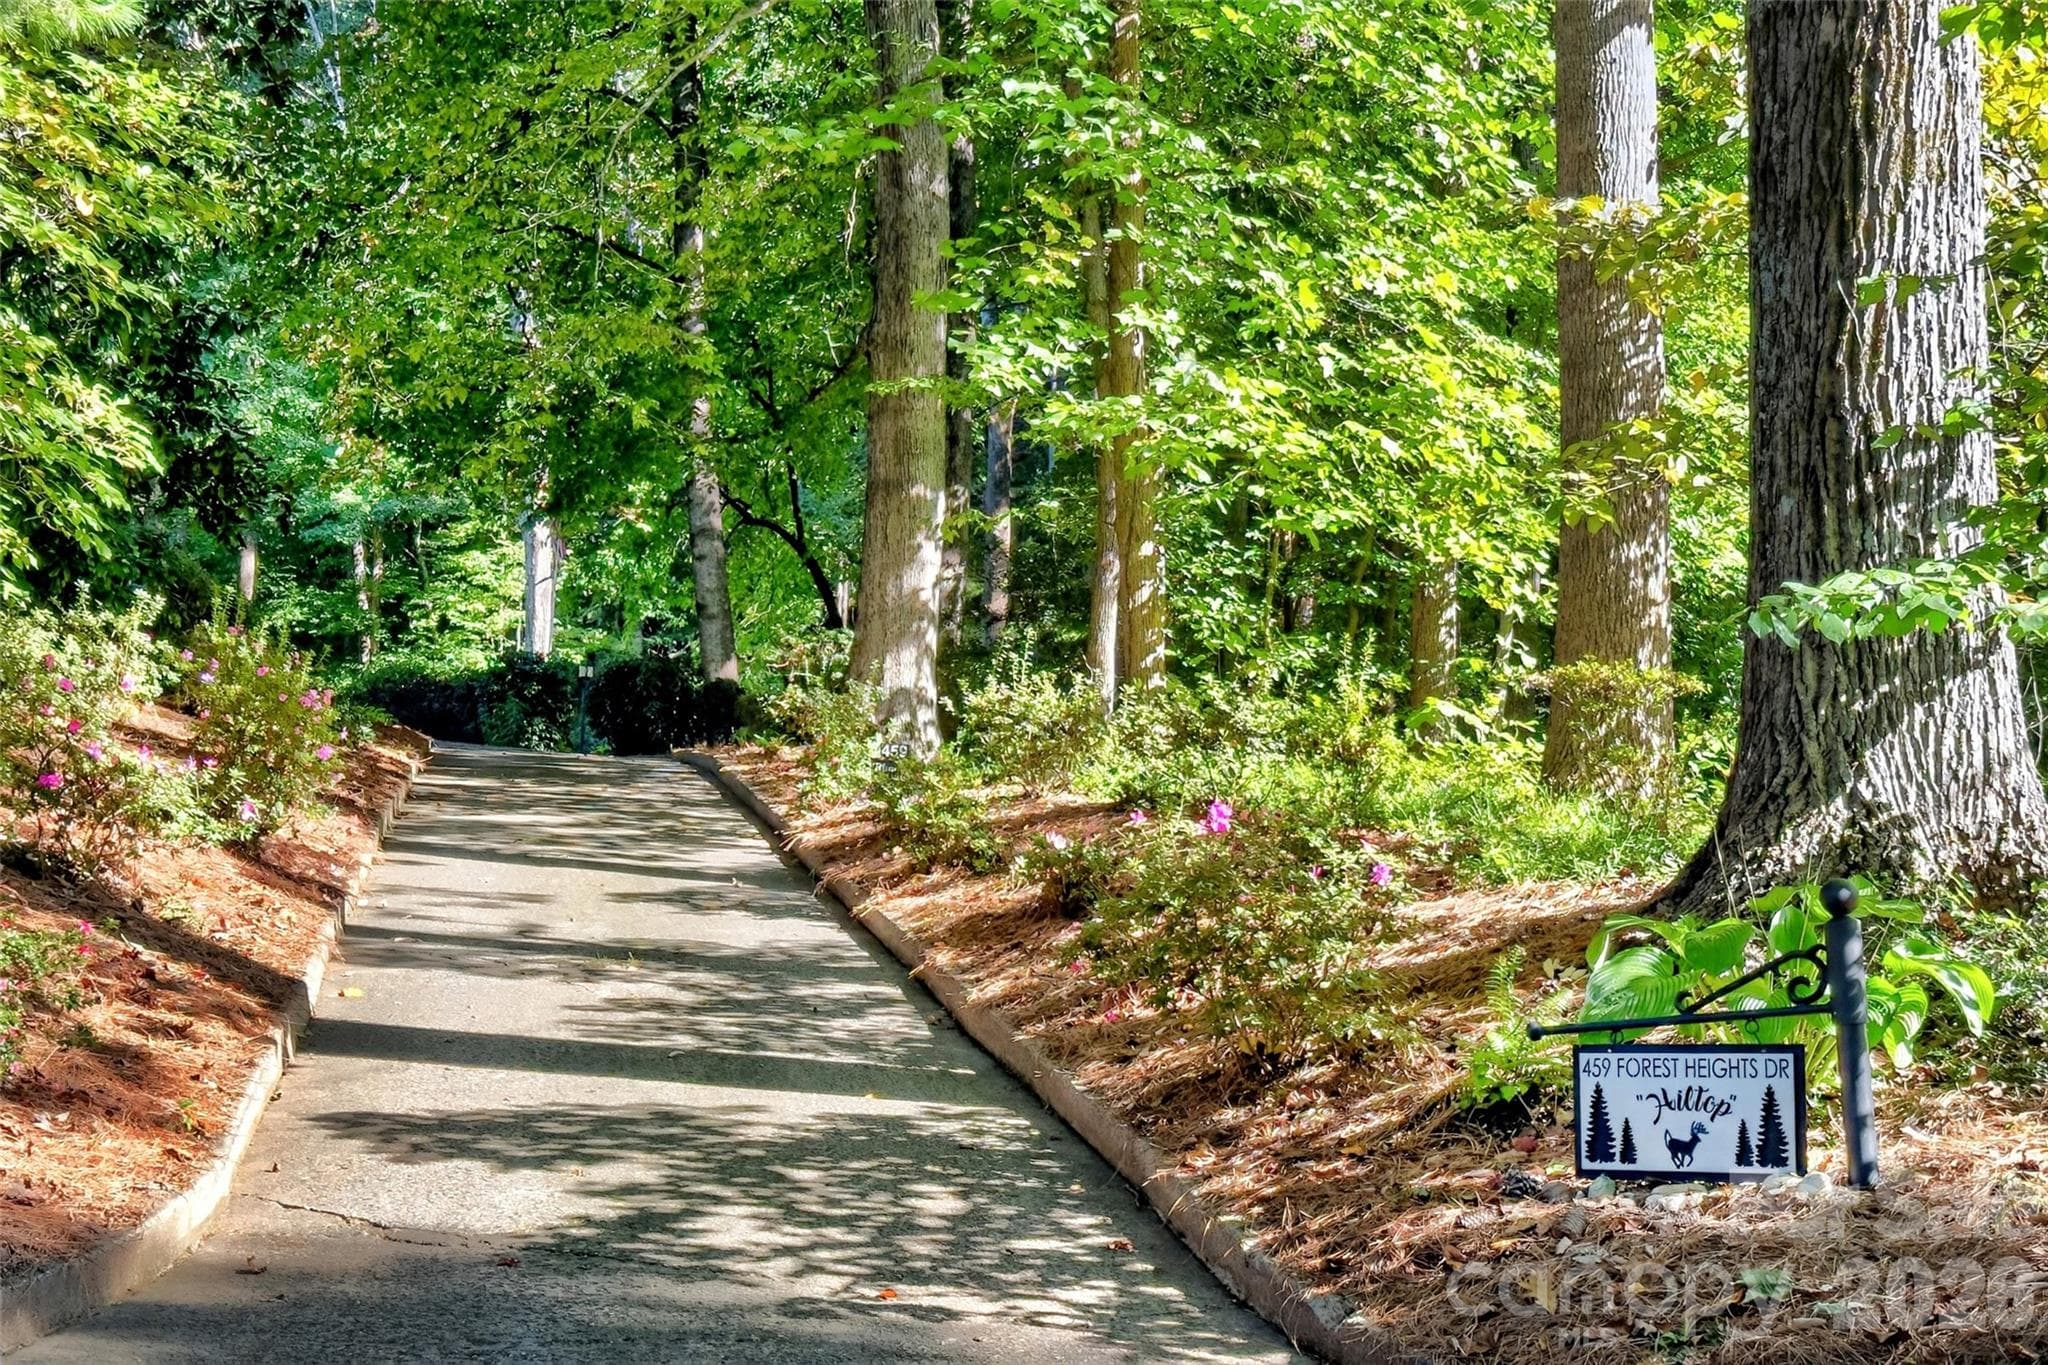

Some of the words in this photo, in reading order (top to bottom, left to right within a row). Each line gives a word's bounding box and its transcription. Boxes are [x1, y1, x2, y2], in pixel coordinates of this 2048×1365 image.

[881, 744, 908, 758] 459
[1582, 1058, 1611, 1079] 459
[1616, 1057, 1679, 1079] FOREST
[1685, 1057, 1759, 1079] HEIGHTS
[1765, 1057, 1790, 1079] DR
[1636, 1085, 1738, 1125] "Hiltop"
